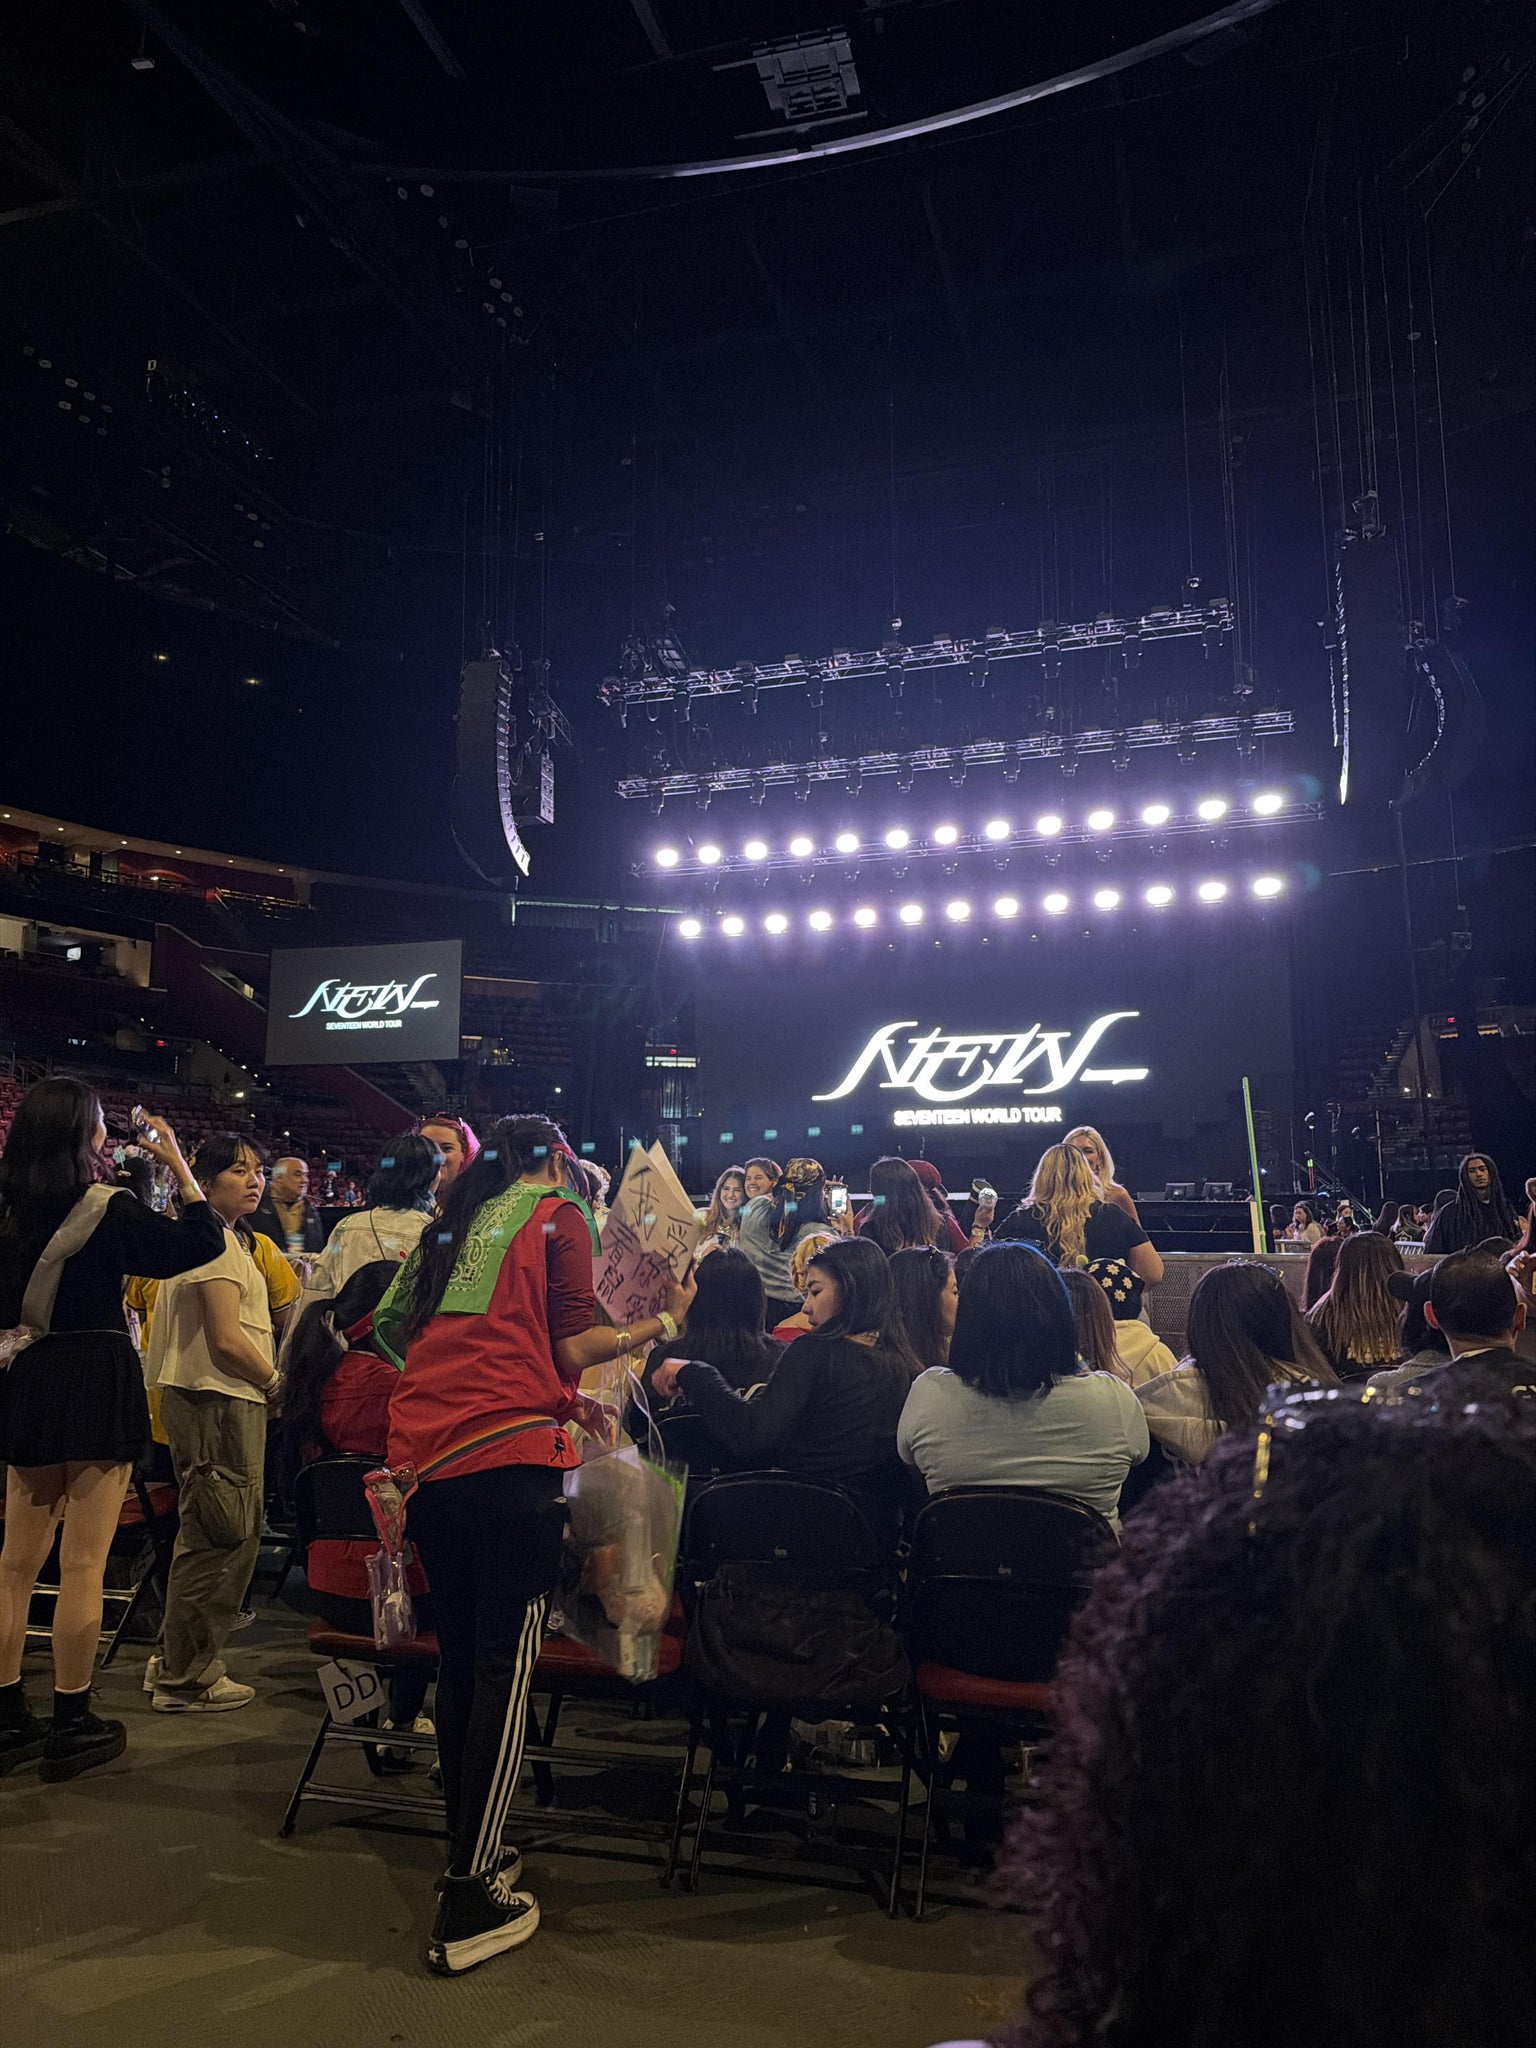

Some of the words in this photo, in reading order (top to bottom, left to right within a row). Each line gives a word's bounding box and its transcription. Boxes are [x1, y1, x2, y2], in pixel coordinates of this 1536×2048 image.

[325, 1021, 361, 1030] SEVENTEEN
[361, 1020, 384, 1029] WORLD
[384, 1019, 402, 1028] TOUR
[893, 1109, 970, 1126] SEVENTEEN
[971, 1107, 1021, 1124] WORLD
[1022, 1106, 1062, 1122] TOUR
[333, 1673, 377, 1710] DD
